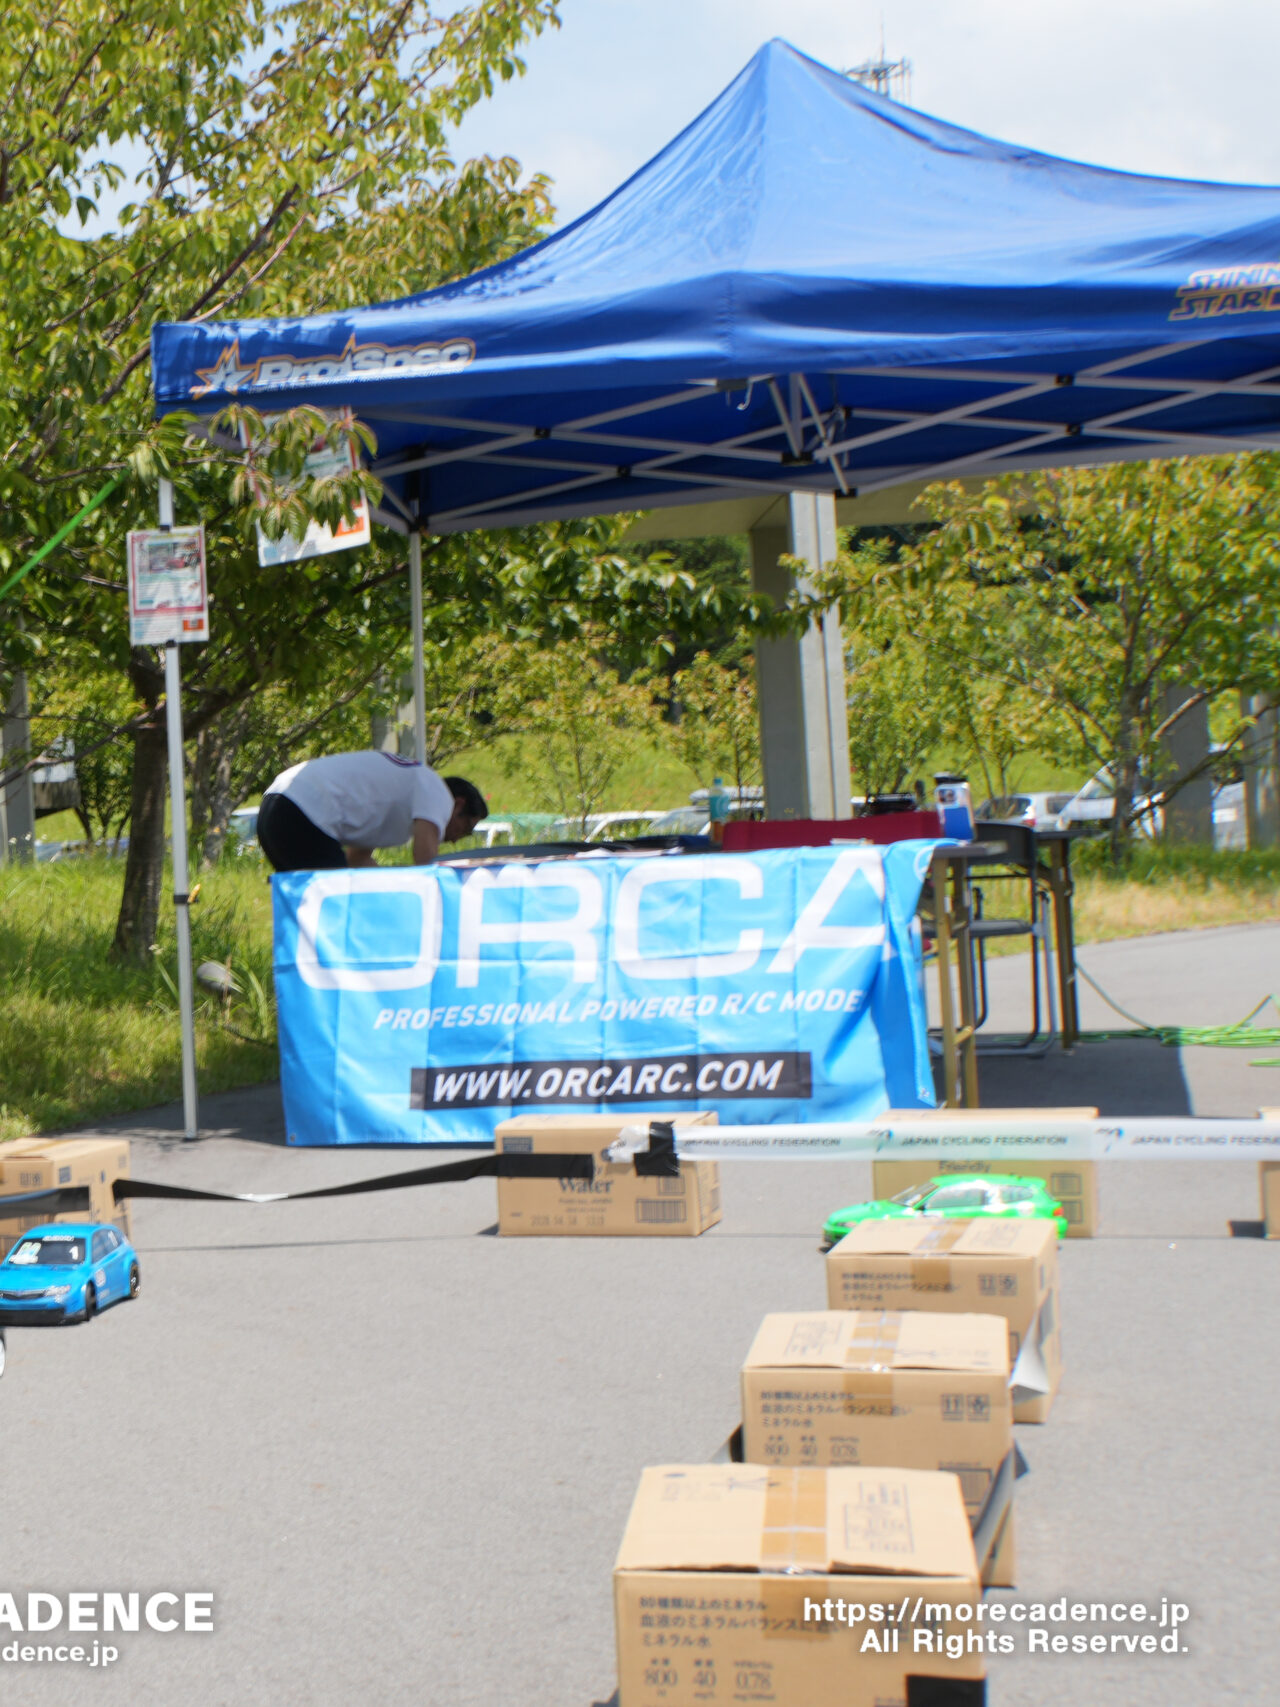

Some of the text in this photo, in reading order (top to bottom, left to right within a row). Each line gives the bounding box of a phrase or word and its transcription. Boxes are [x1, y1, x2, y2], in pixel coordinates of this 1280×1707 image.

[296, 847, 887, 992] ORCA
[373, 1001, 575, 1030] PROFESSIONAL
[580, 994, 718, 1023] POWERED
[721, 990, 777, 1017] R/C
[432, 1059, 784, 1104] WWW.ORCARC.COM
[994, 1135, 1069, 1146] FEDERATION
